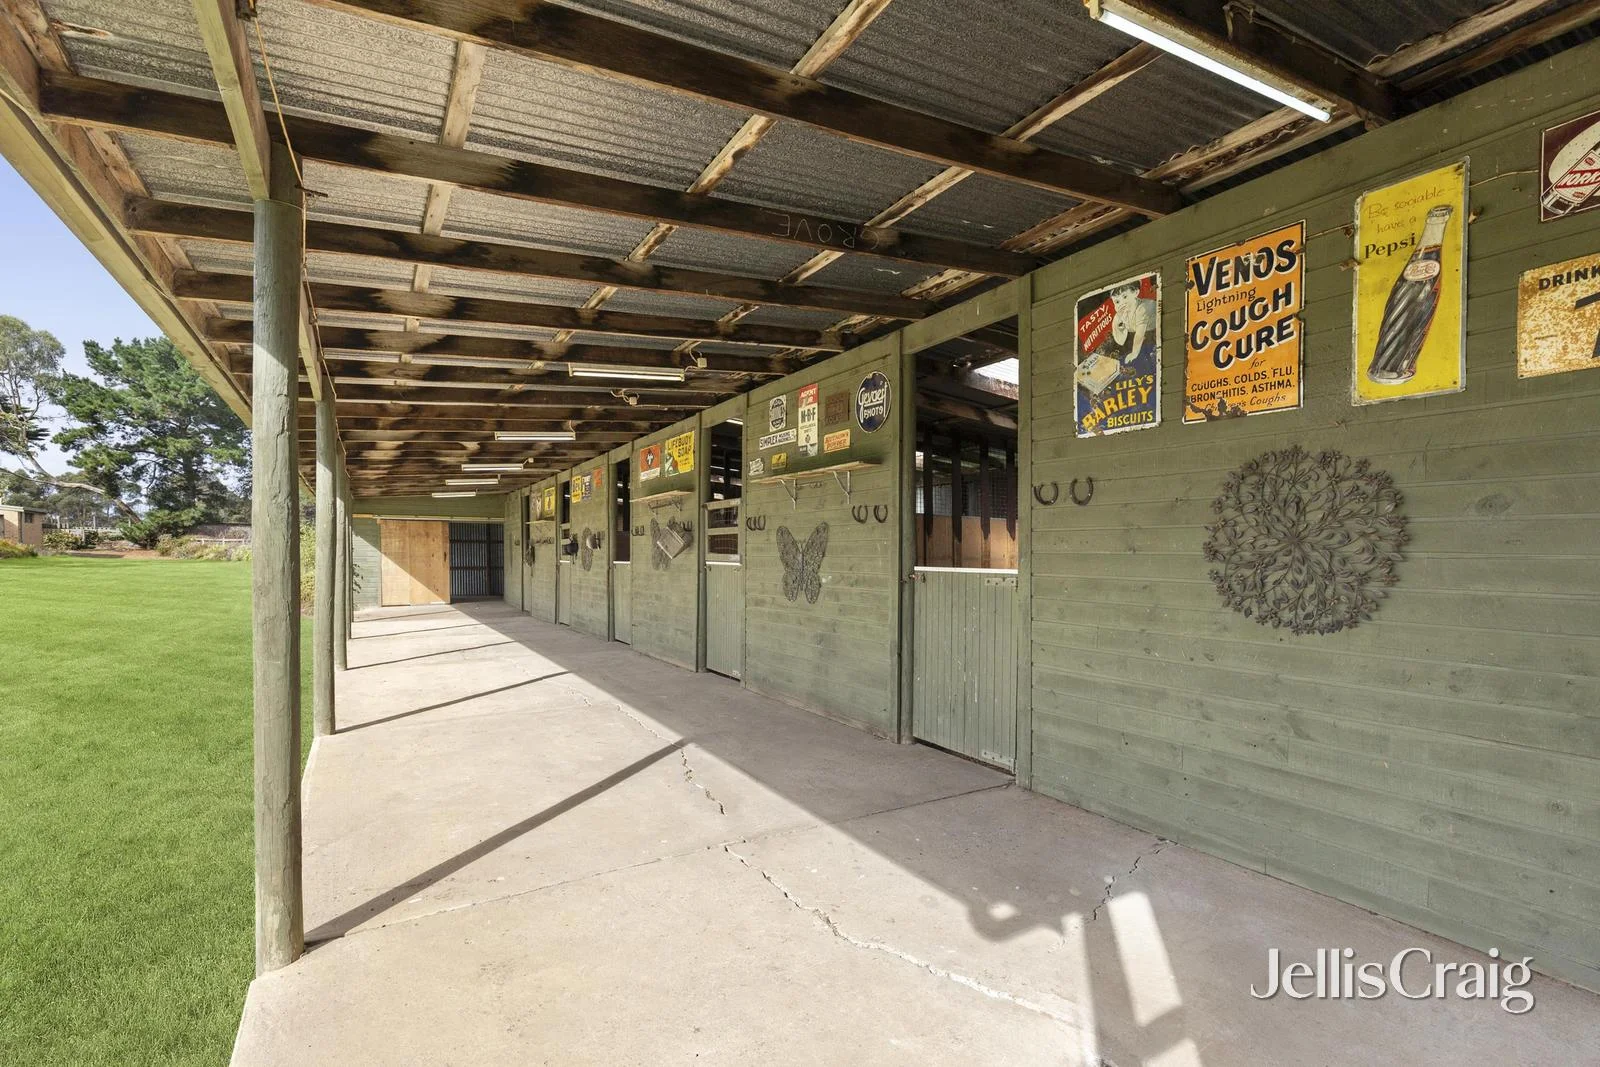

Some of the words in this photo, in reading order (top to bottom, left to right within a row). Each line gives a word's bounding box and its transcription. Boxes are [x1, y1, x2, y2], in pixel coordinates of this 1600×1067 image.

[1366, 203, 1389, 219] Be
[1394, 187, 1446, 210] sociable
[1377, 220, 1405, 234] have
[1409, 216, 1417, 224] a
[1363, 233, 1416, 258] Pepsi
[1192, 239, 1297, 297] VENOS
[1538, 264, 1600, 291] DRINK
[1196, 286, 1257, 315] Lightning
[1080, 304, 1106, 333] TASTY
[1190, 281, 1293, 351] COUGH
[1083, 313, 1113, 352] NUTRITIOUS
[1212, 314, 1298, 370] CURE
[1249, 357, 1266, 370] for
[1115, 374, 1154, 391] LILY'S
[1081, 386, 1153, 432] BARLEY
[1249, 392, 1287, 407] Coughs
[1107, 410, 1154, 428] BISCUITS
